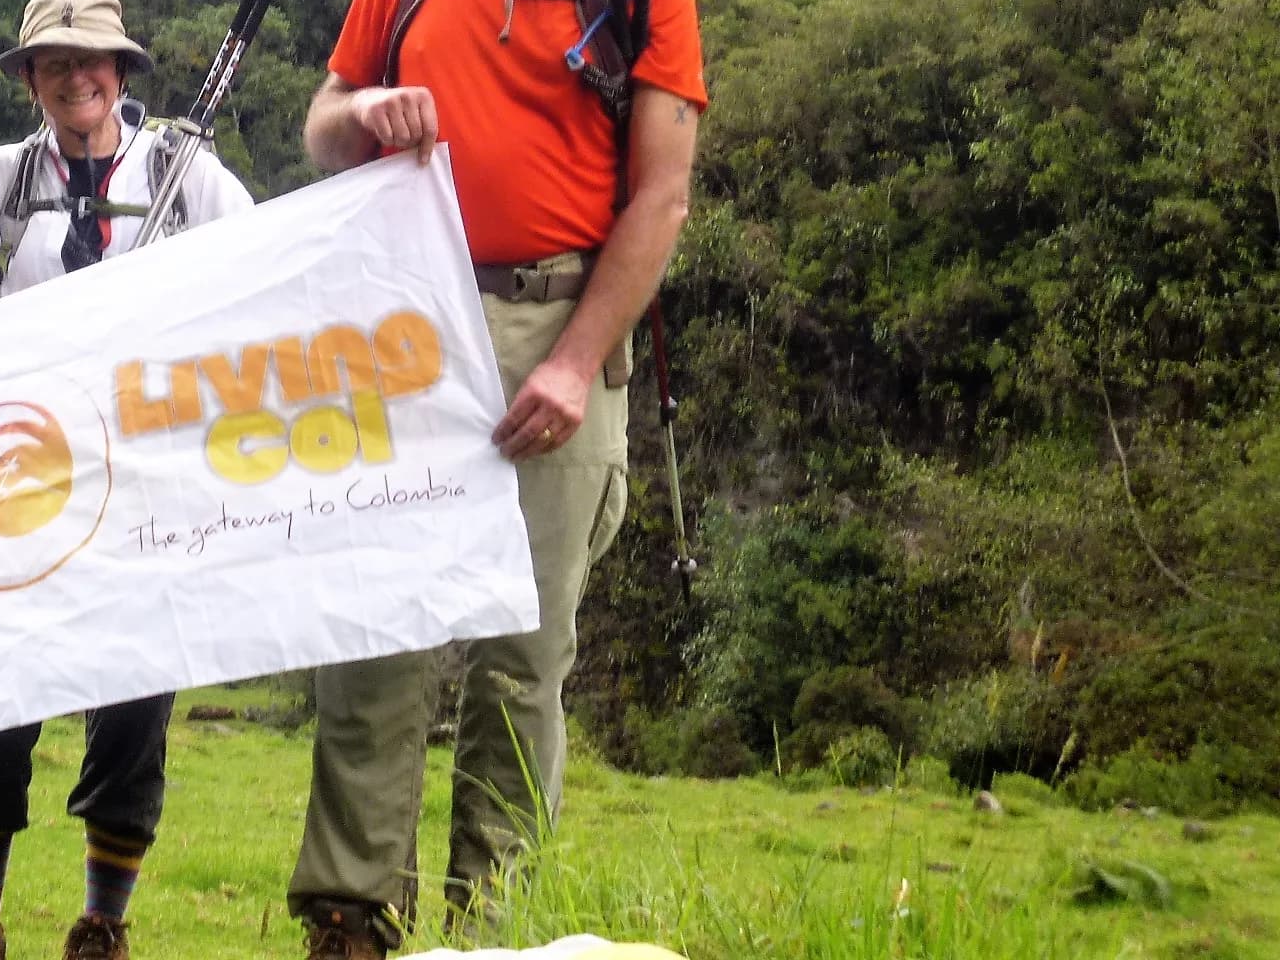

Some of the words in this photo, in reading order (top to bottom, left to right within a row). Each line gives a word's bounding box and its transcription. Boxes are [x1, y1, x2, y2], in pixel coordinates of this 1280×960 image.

[128, 515, 177, 552] The
[187, 502, 293, 555] gateway
[304, 488, 335, 517] to
[346, 467, 466, 510] Colombia
